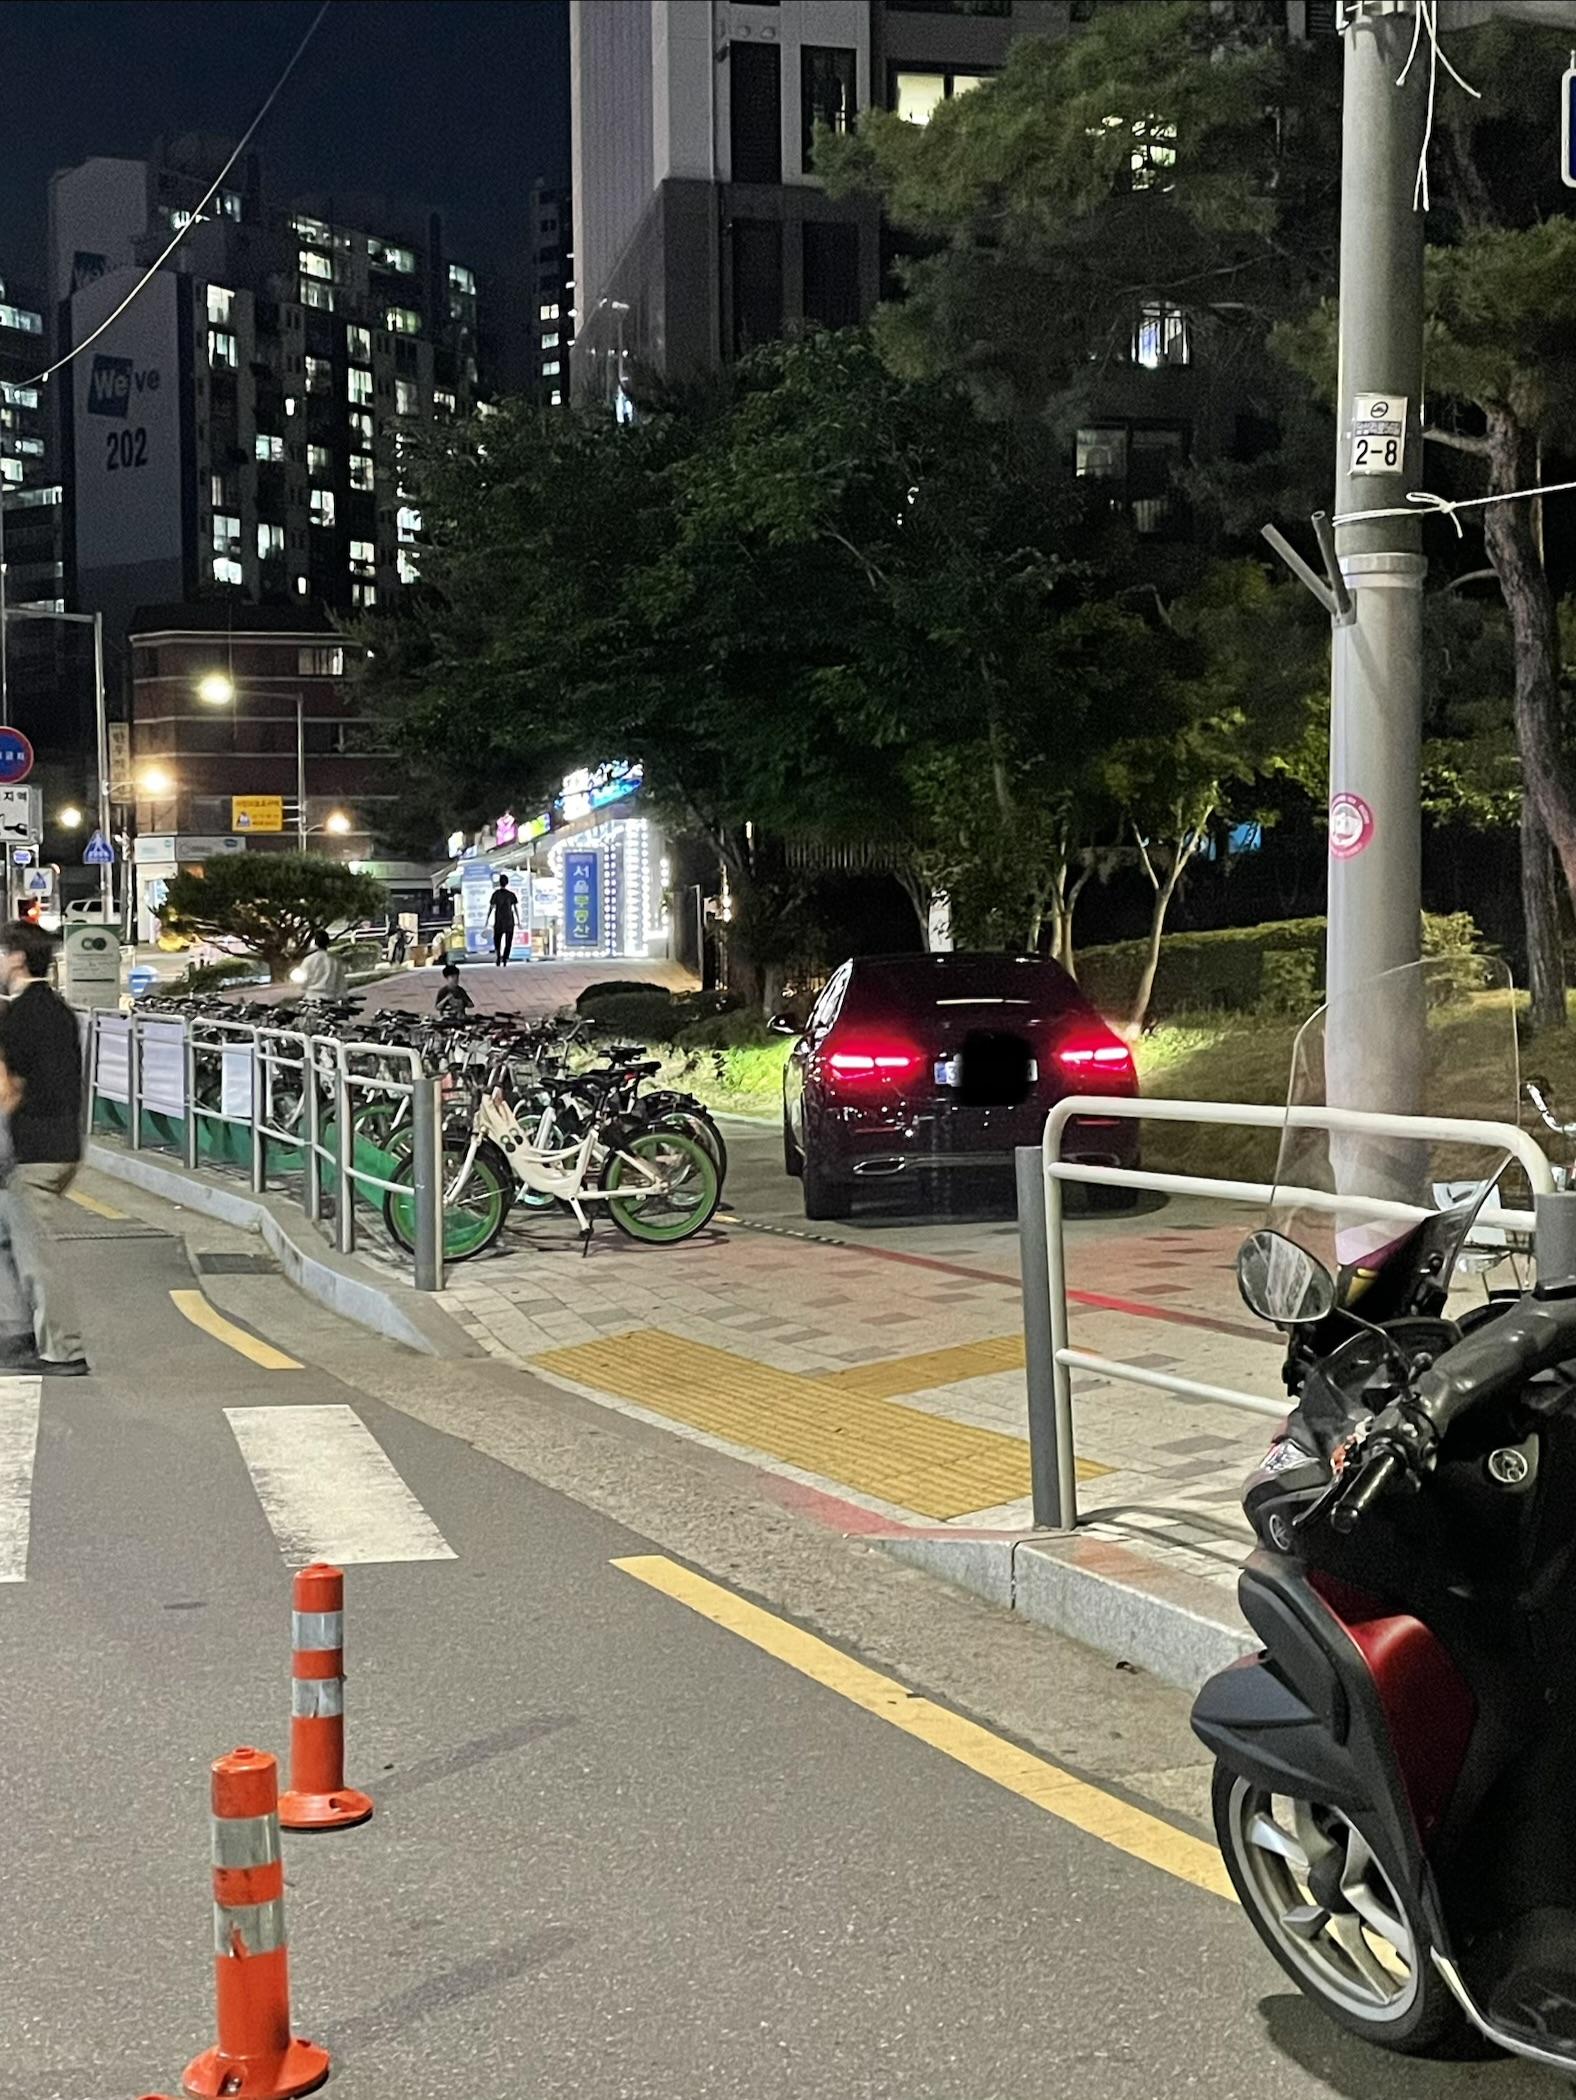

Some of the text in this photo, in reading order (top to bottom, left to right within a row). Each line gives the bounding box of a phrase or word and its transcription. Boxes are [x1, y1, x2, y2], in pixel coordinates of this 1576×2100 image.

[107, 427, 148, 471] 202
[1355, 439, 1397, 466] 2-8
[0, 751, 25, 761] 금지
